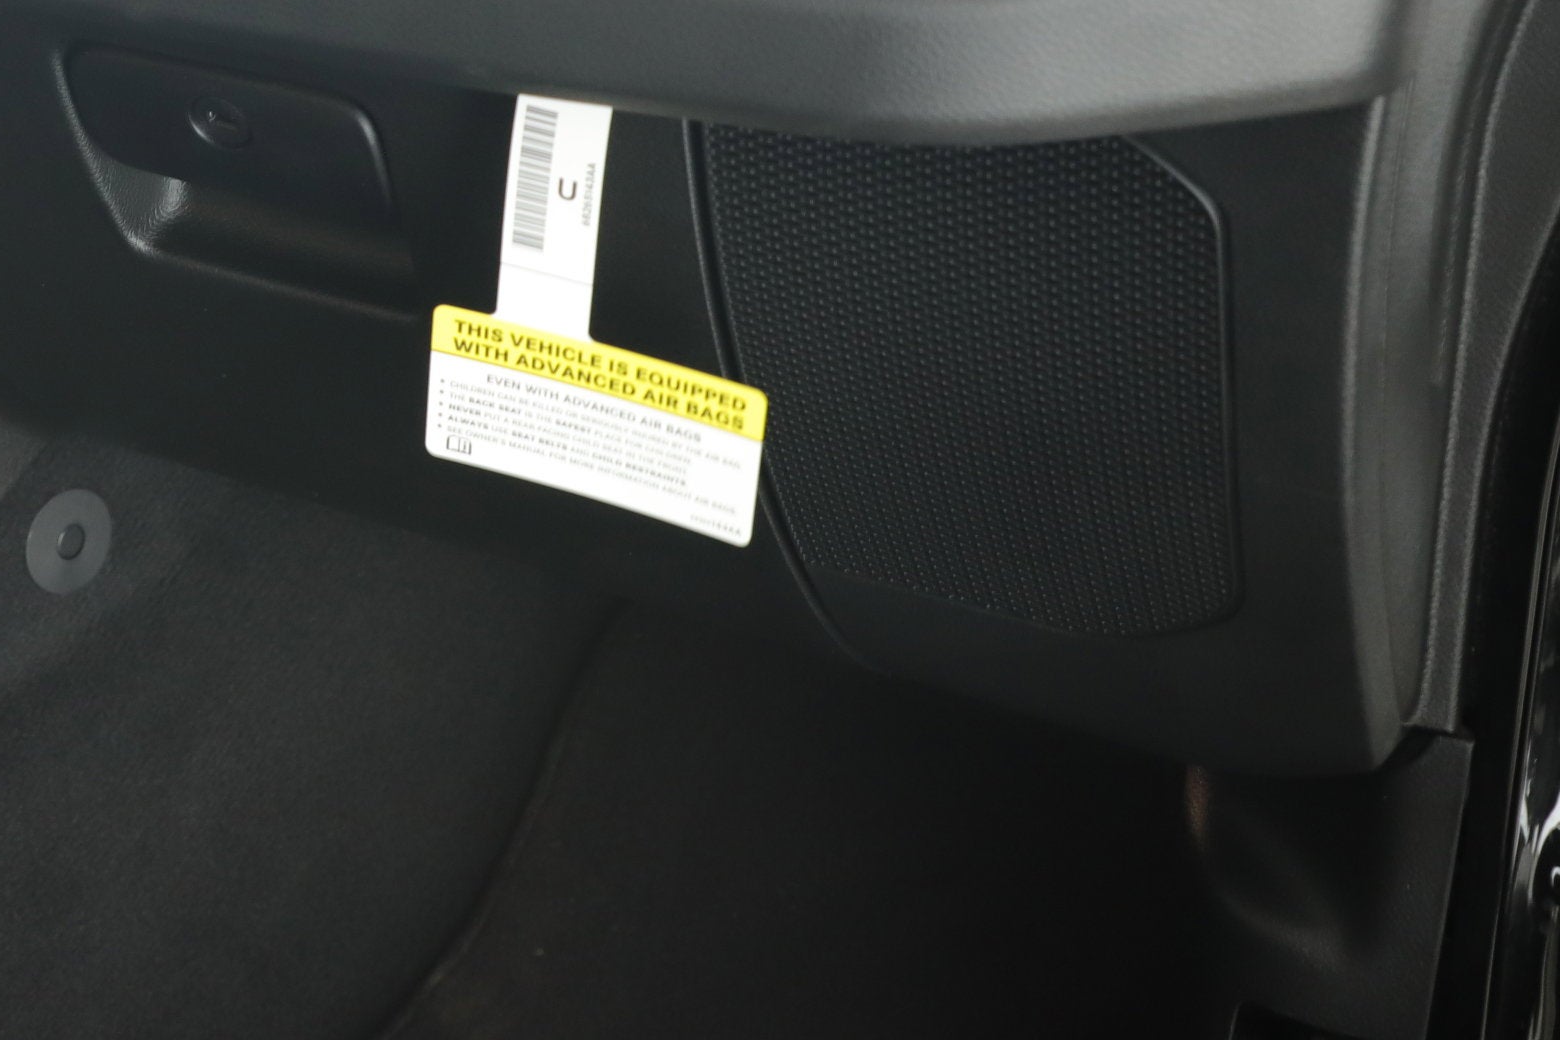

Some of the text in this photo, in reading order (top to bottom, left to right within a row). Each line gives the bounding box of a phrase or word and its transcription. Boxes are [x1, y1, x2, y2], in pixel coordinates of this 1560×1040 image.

[453, 337, 746, 431] WITH ADVANCED AIR BAGS
[454, 319, 748, 412] THIS VEHICLE IS EQUIPPED
[487, 374, 701, 443] EVEN WITH ADVANCED AIR BAGS
